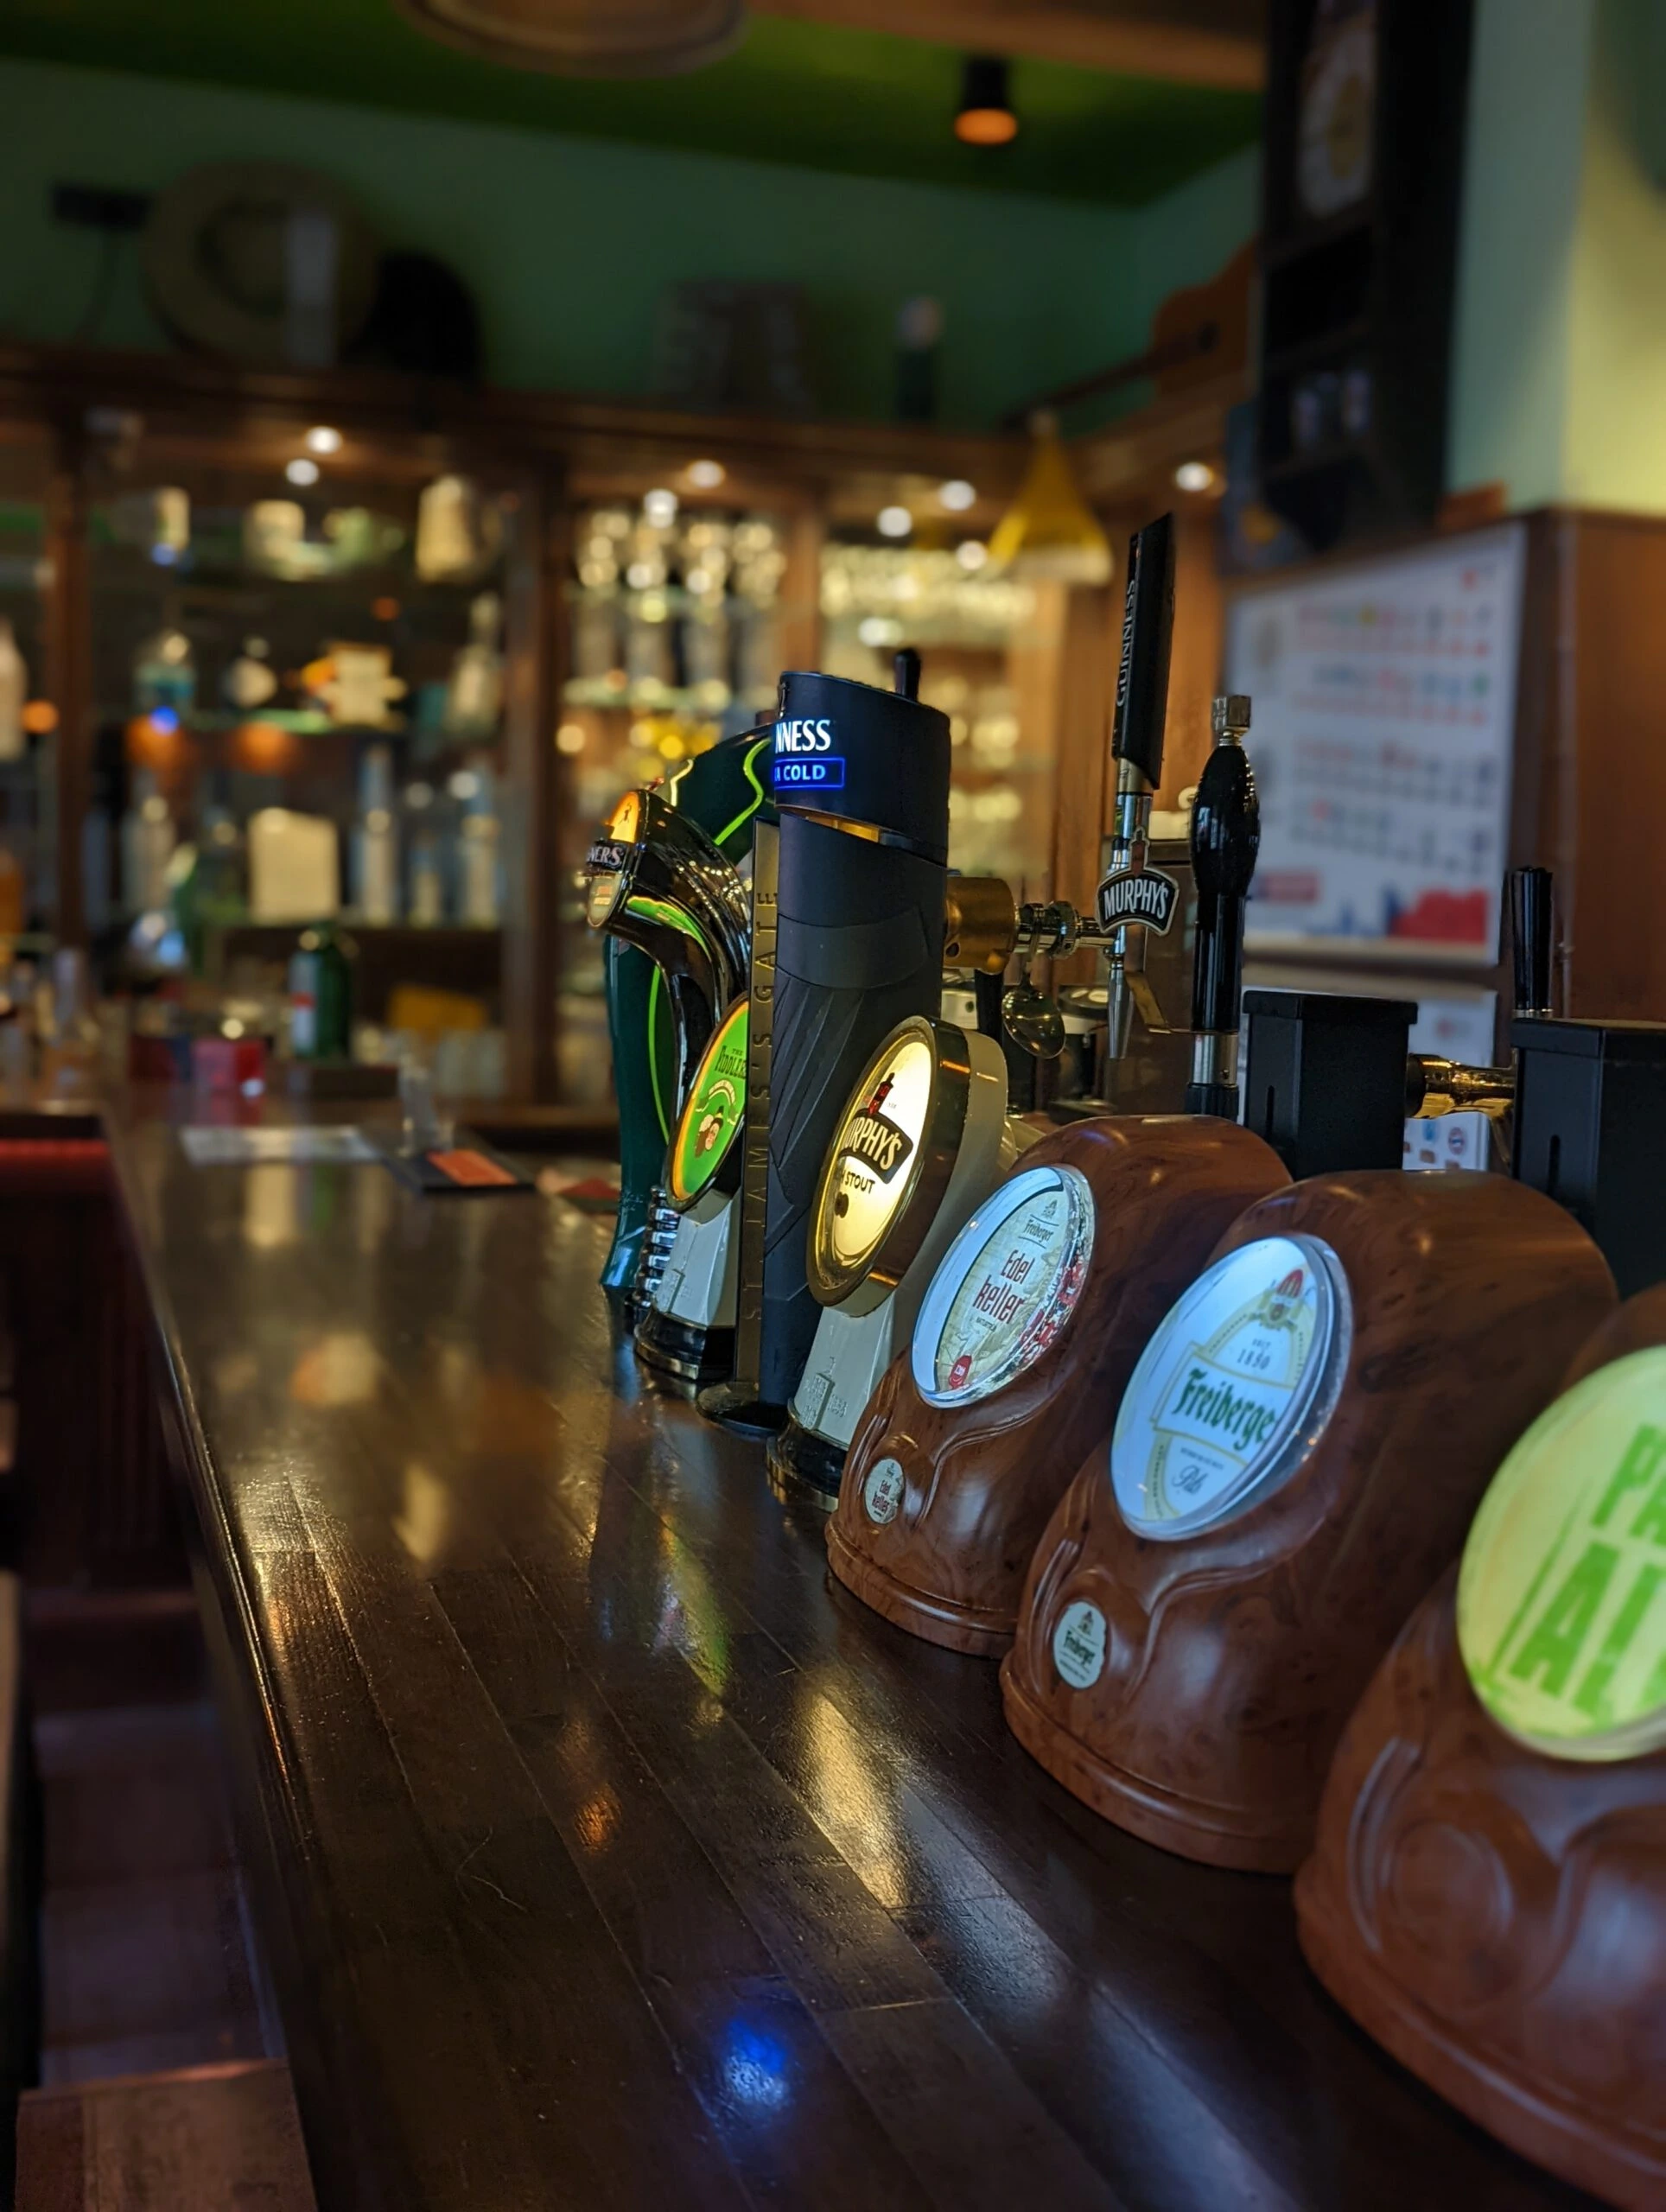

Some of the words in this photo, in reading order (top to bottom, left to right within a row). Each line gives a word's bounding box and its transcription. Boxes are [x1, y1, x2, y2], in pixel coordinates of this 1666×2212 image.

[783, 765, 826, 781] COLD
[1103, 878, 1169, 920] MURPHY'S
[754, 893, 778, 1004] GATE
[845, 1171, 875, 1194] STOUT
[1001, 1249, 1035, 1285] Edel
